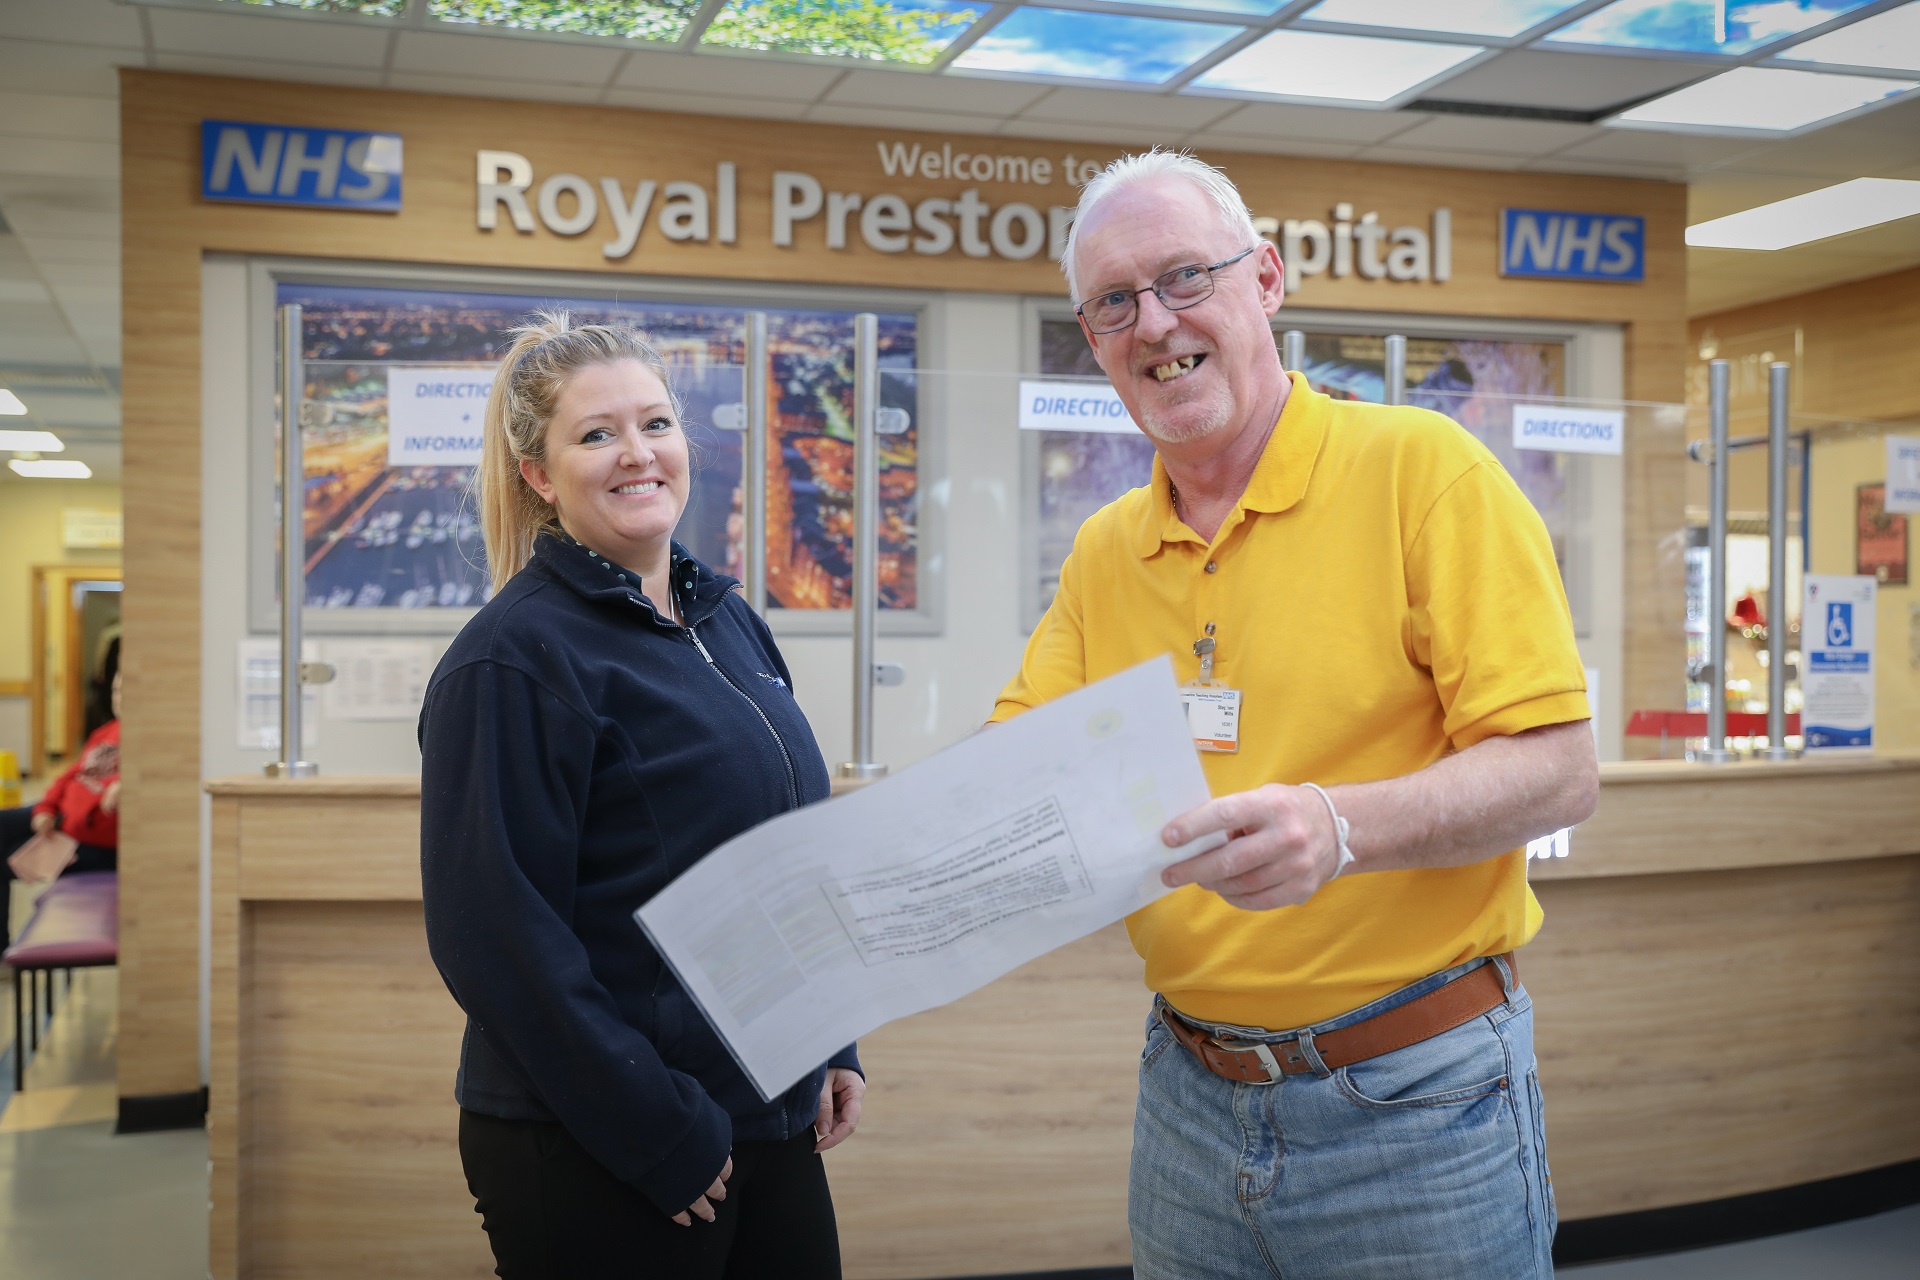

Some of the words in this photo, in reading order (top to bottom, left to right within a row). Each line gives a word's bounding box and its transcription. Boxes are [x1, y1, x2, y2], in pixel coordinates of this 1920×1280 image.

[209, 127, 389, 201] NHS
[877, 141, 1052, 185] Welcome
[1062, 153, 1103, 186] to
[476, 149, 738, 259] Royal
[1509, 214, 1638, 274] NHS
[1522, 418, 1614, 440] DIRECTIONS
